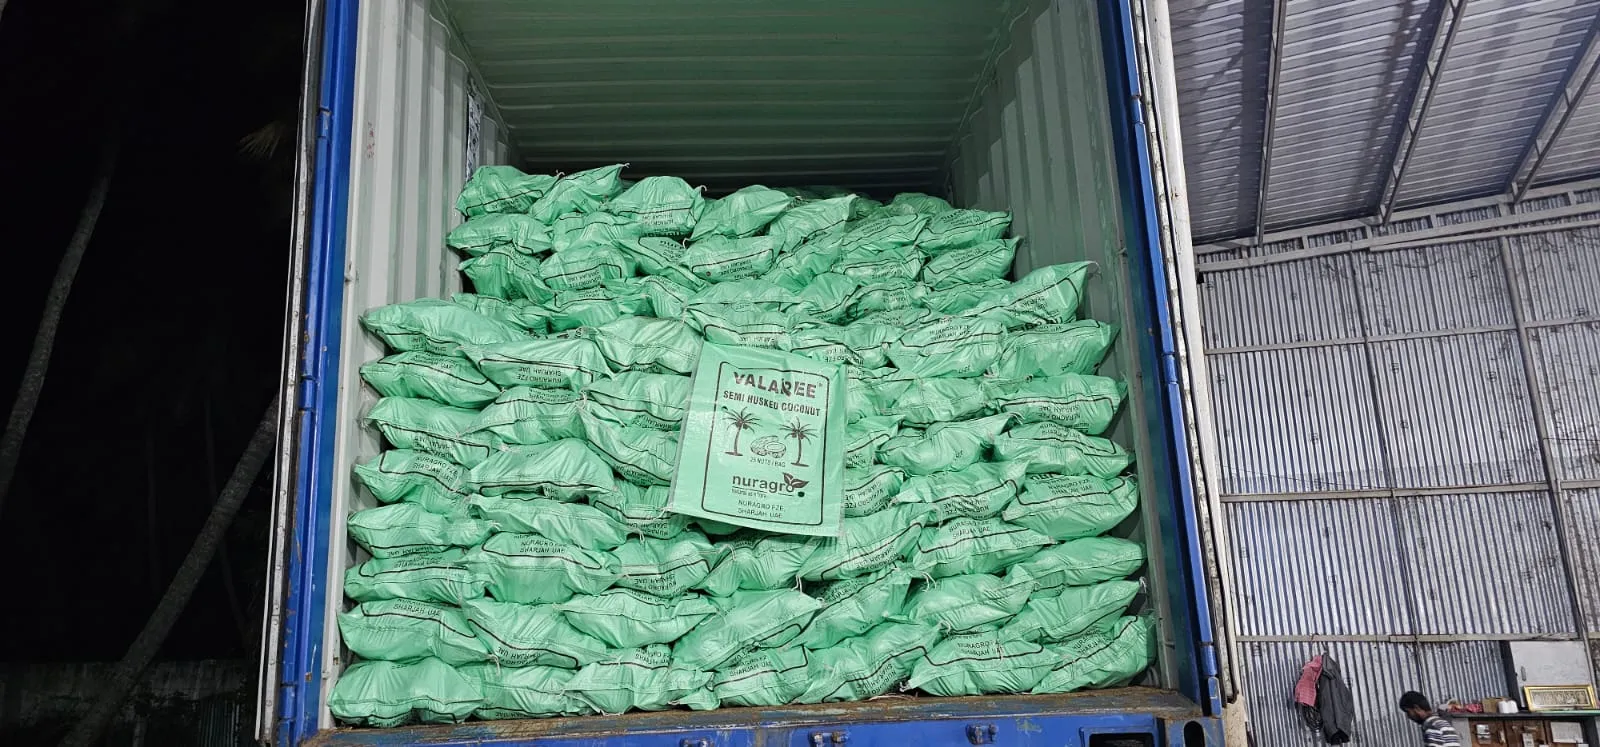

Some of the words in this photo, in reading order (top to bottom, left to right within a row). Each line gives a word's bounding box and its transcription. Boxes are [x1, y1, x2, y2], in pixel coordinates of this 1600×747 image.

[723, 390, 745, 401] SEMI
[747, 395, 779, 410] HUSKED
[781, 402, 821, 417] COCONUT
[757, 458, 771, 466] NUTS
[732, 475, 795, 494] nuragro
[738, 499, 771, 510] NURAGRO
[737, 507, 768, 517] SHARJAH
